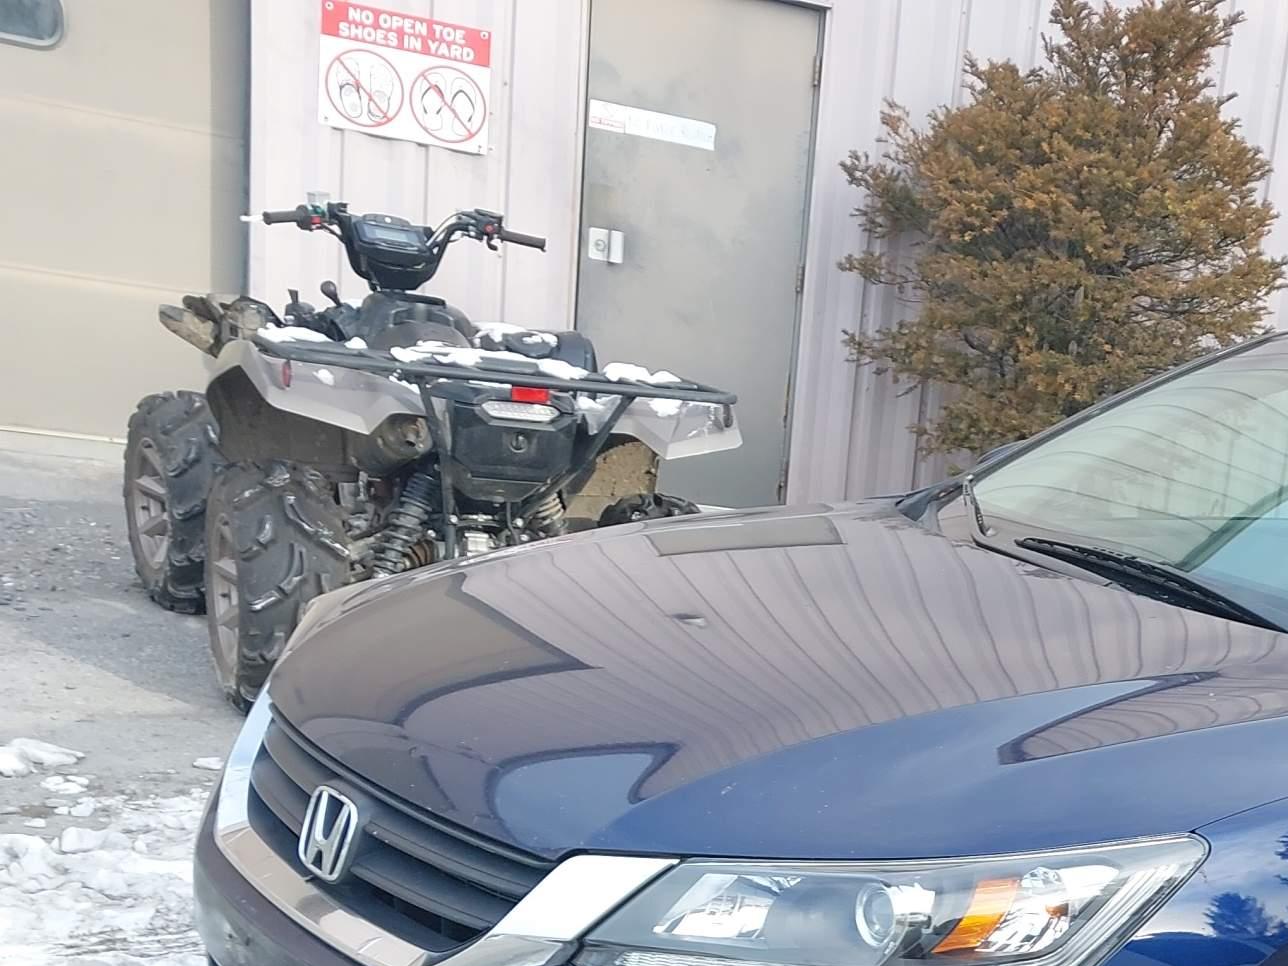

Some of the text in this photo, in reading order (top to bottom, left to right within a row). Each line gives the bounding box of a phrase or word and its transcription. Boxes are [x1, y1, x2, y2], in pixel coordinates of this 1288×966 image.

[338, 22, 475, 62] SHOES IN YARD
[348, 7, 466, 44] NO OPEN TOE
